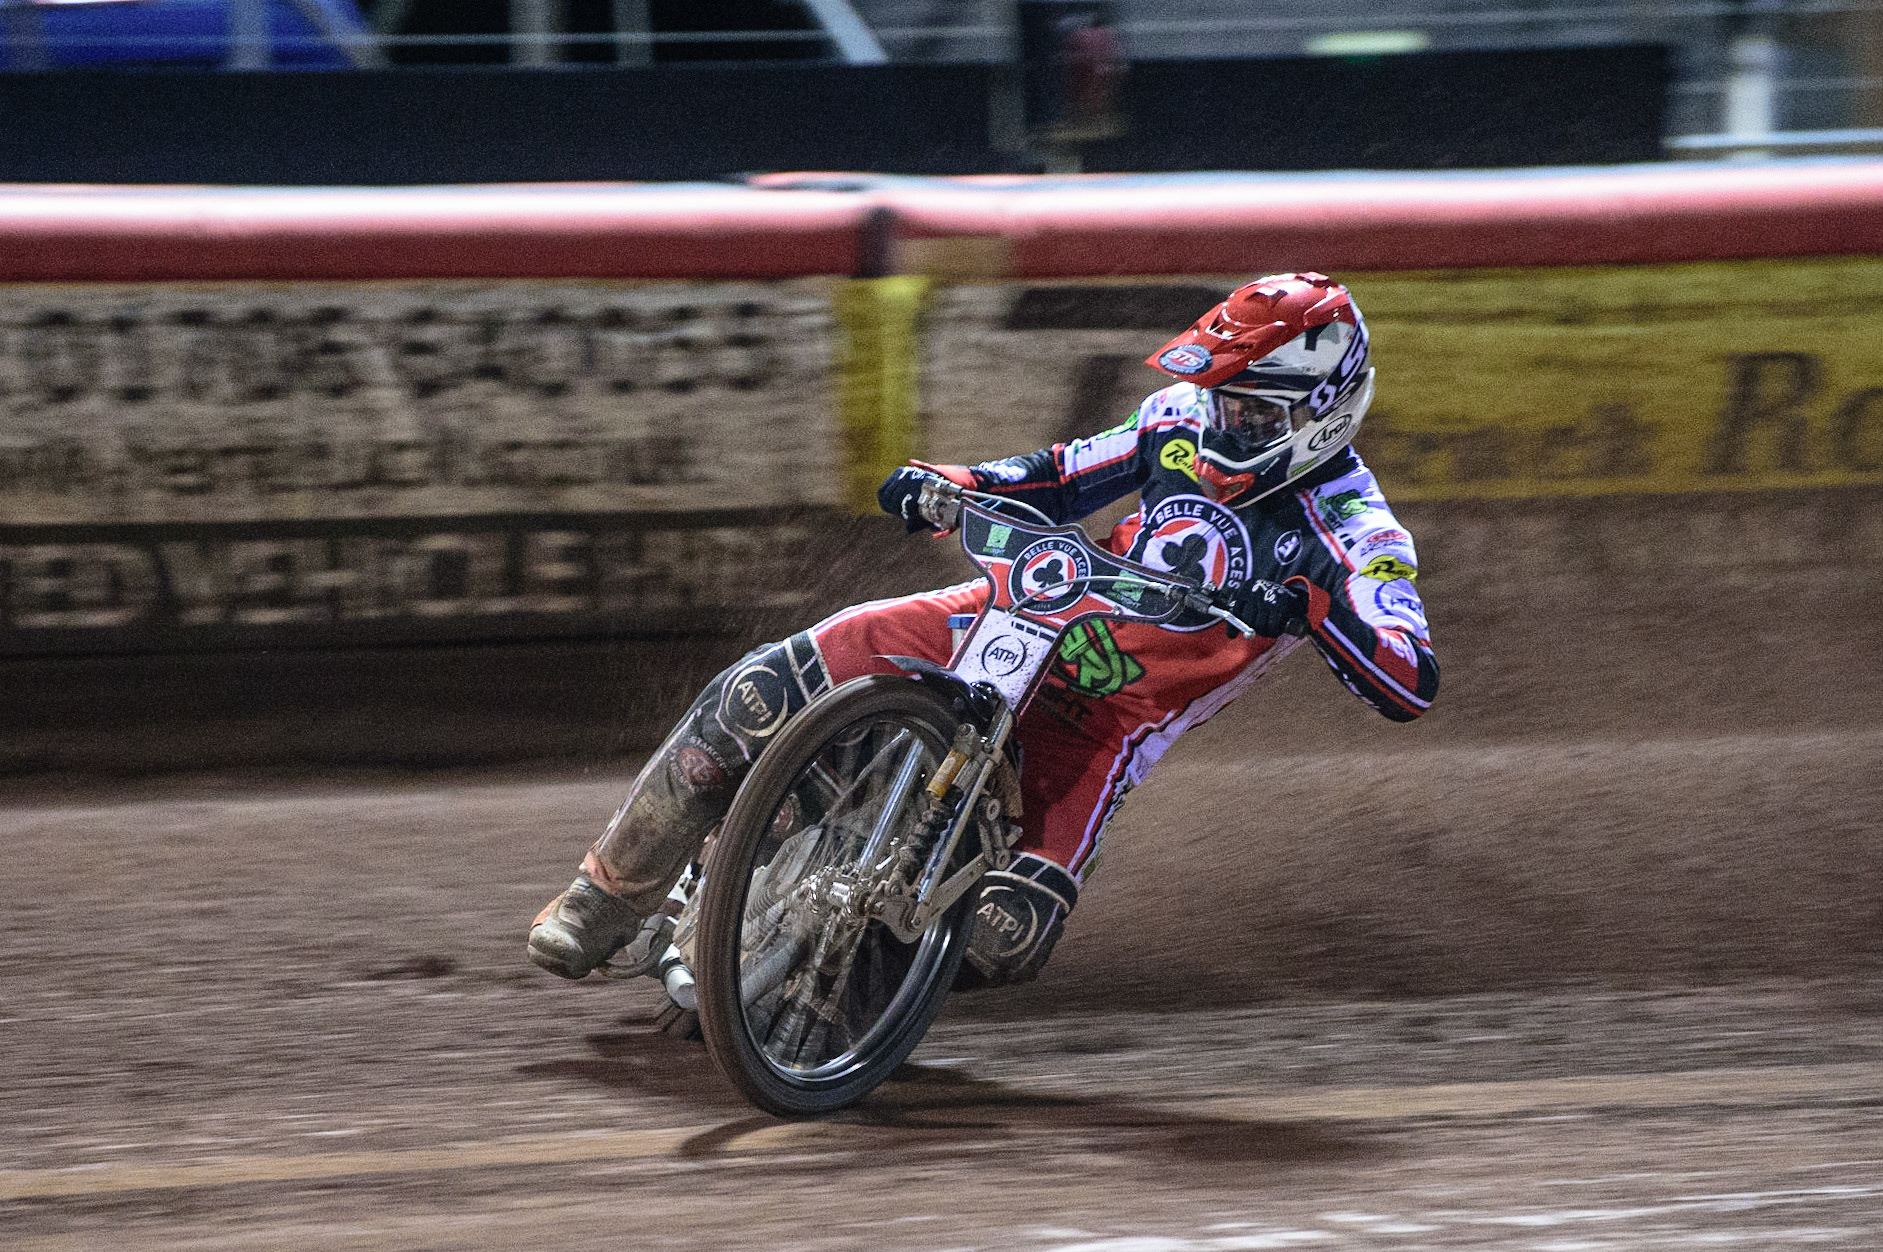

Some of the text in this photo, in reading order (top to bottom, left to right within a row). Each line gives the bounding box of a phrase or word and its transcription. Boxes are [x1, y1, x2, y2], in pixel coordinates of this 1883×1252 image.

[1315, 419, 1349, 444] Arai
[1024, 542, 1054, 561] BELLE
[1059, 541, 1078, 557] VUE
[1155, 503, 1204, 525] BELLE
[1209, 511, 1238, 540] VUE
[1227, 547, 1245, 590] ACES
[988, 646, 1019, 665] ATPI
[738, 681, 774, 724] ATPI
[976, 902, 1025, 941] ATPI
